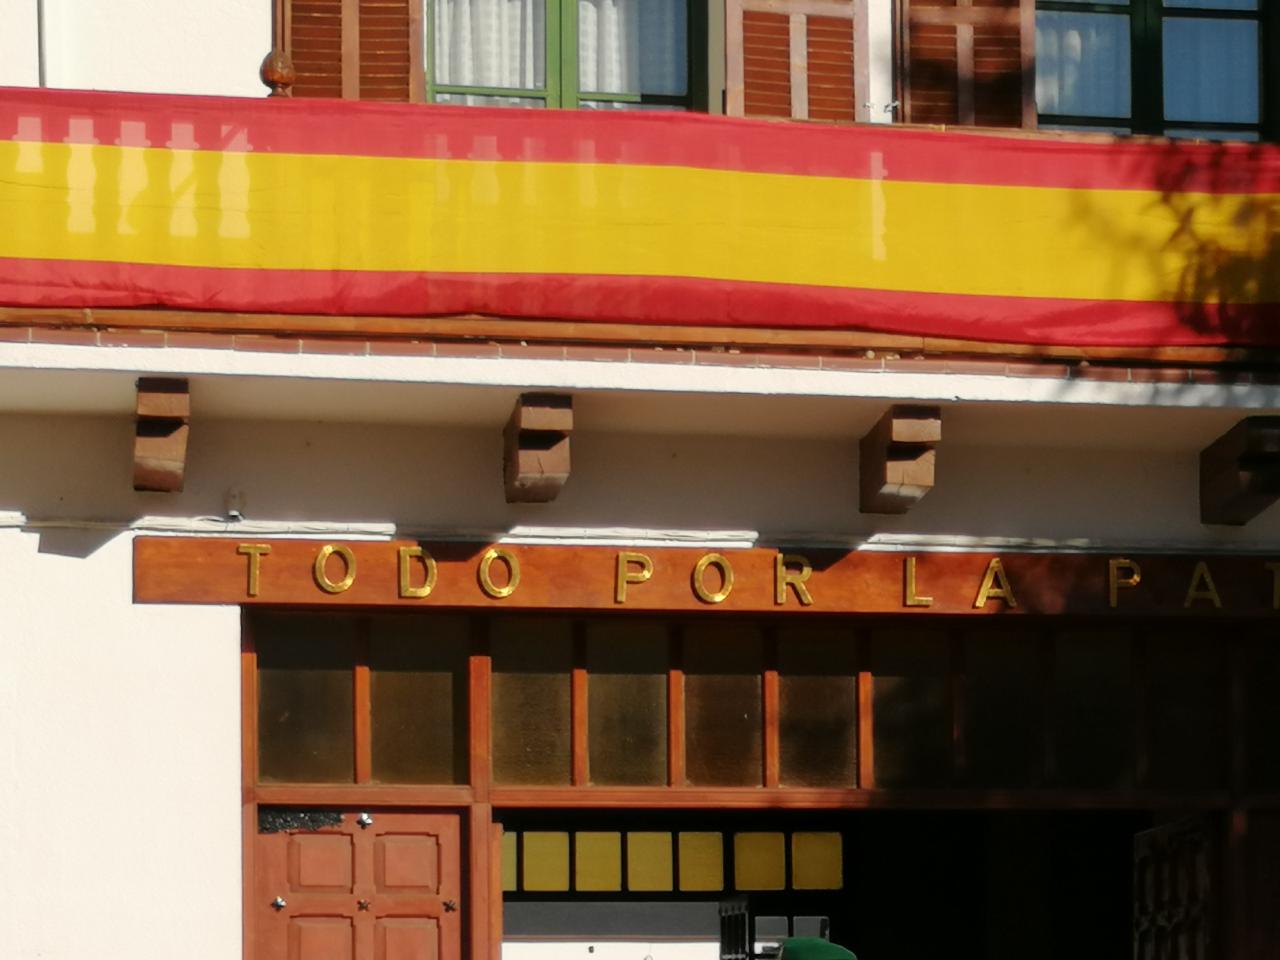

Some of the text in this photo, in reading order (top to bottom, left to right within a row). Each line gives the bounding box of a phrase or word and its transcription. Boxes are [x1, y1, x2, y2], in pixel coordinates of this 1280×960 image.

[238, 543, 521, 599] TODO
[616, 551, 813, 604] POR
[903, 555, 1018, 610] LA
